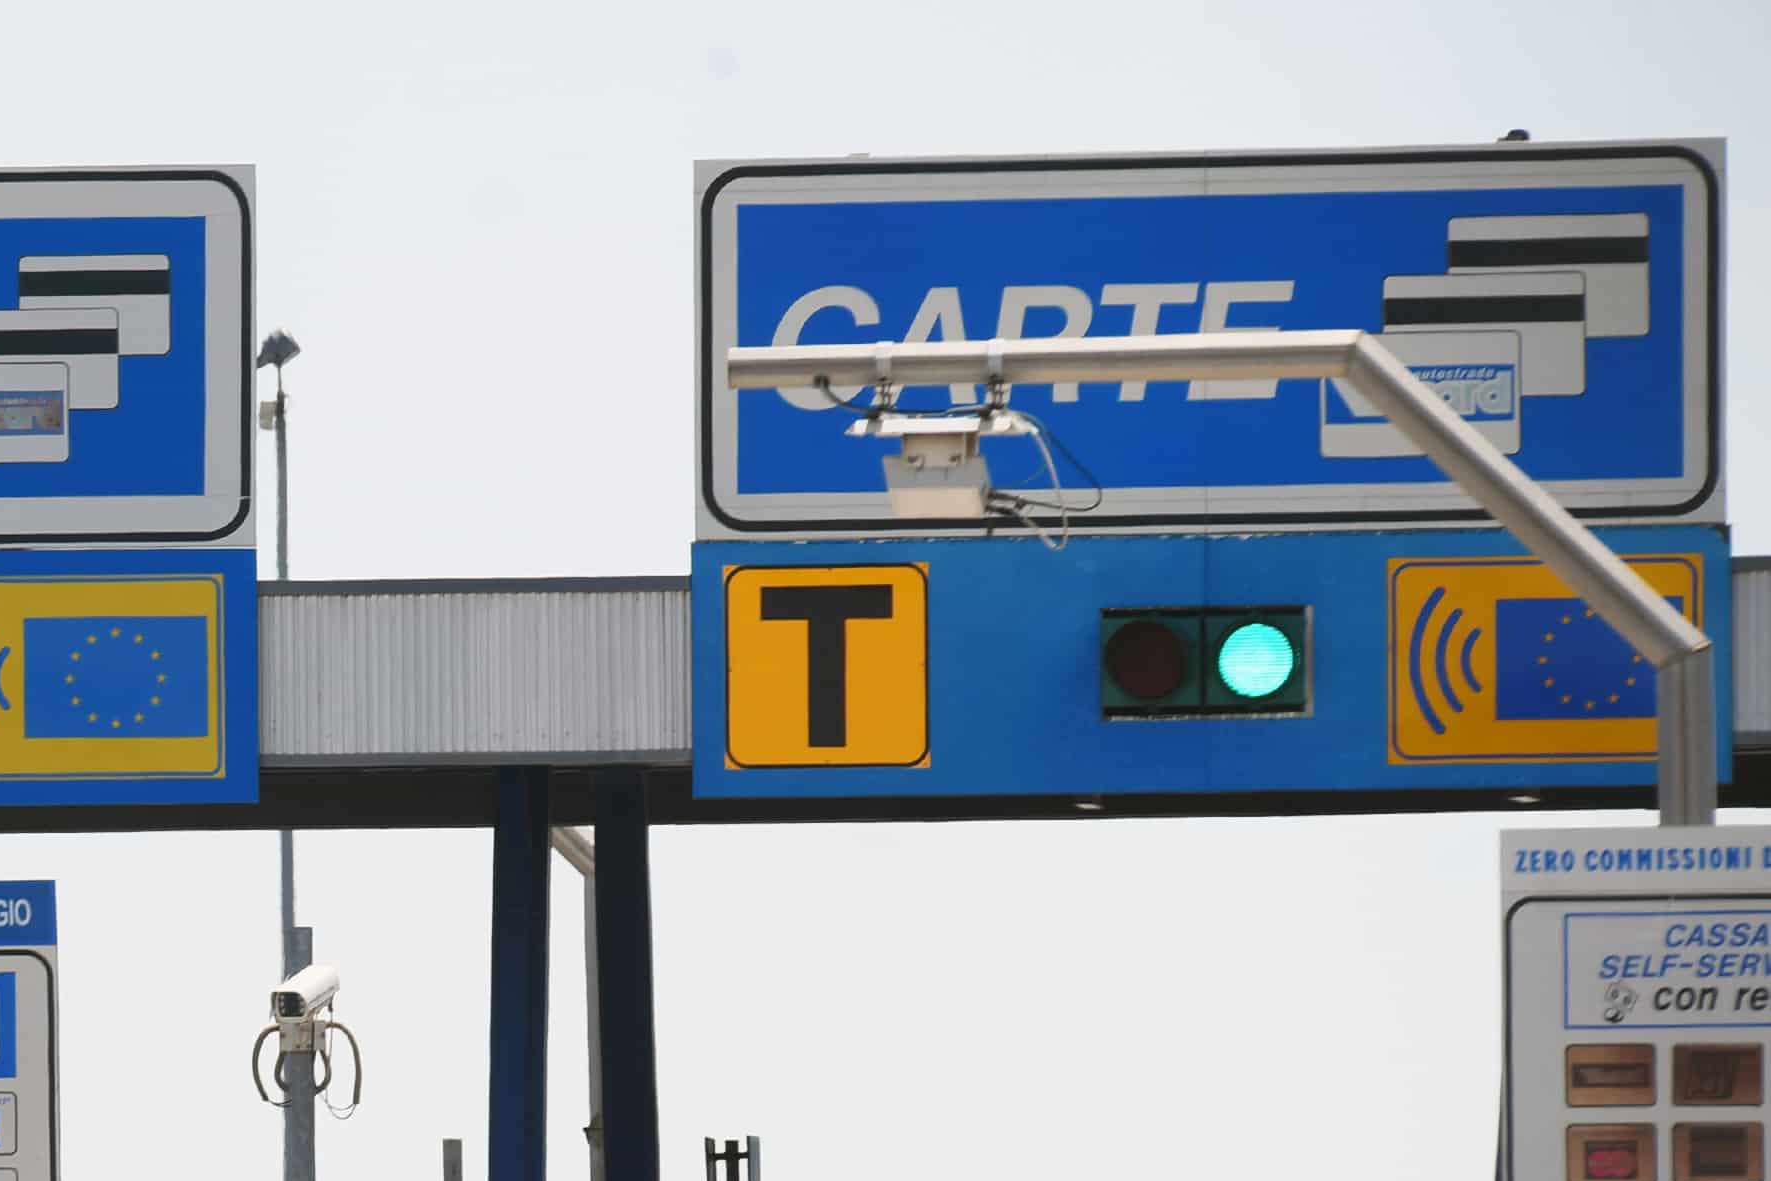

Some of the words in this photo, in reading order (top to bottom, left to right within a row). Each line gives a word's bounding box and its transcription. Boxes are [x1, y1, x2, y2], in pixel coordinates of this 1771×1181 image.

[771, 280, 1295, 410] CARTE
[760, 584, 893, 747] T
[1515, 848, 1576, 873] ZERO
[1584, 846, 1752, 872] COMMISSIONI
[1665, 922, 1769, 948] CASSA
[1653, 986, 1719, 1011] con
[1733, 986, 1771, 1011] re
